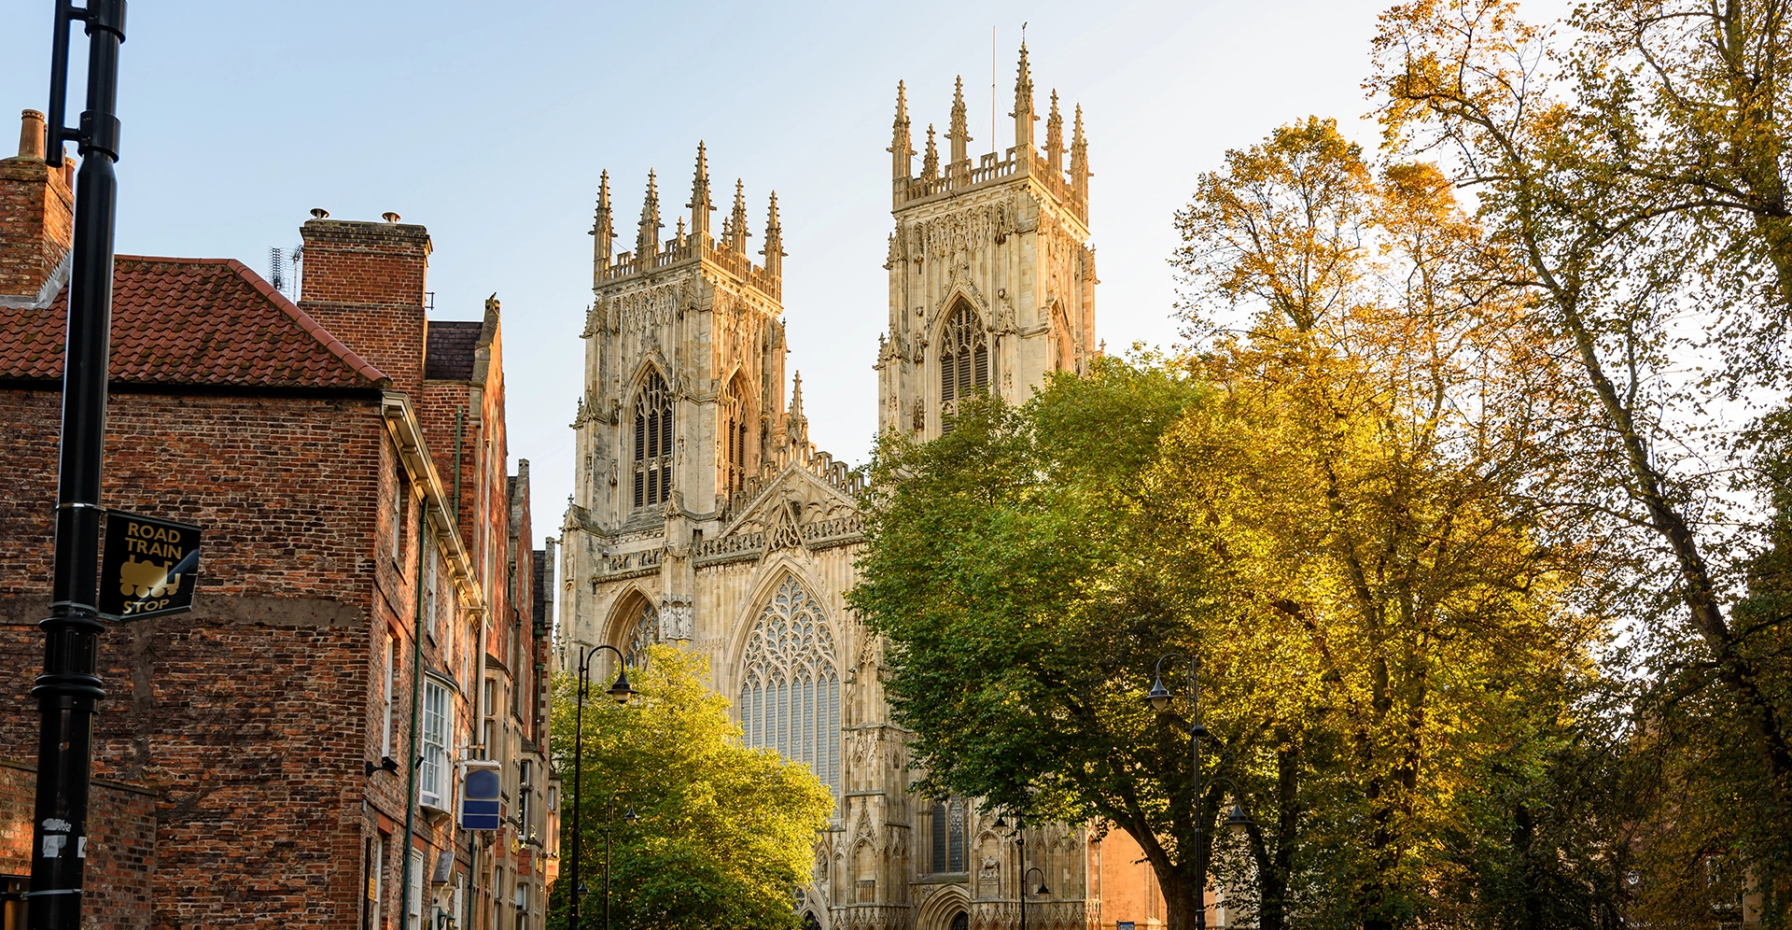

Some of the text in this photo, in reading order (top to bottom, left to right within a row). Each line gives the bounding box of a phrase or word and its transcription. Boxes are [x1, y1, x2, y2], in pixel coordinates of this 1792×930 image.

[128, 522, 180, 543] ROAD
[125, 537, 182, 559] TRAIN
[123, 599, 170, 614] STOP
